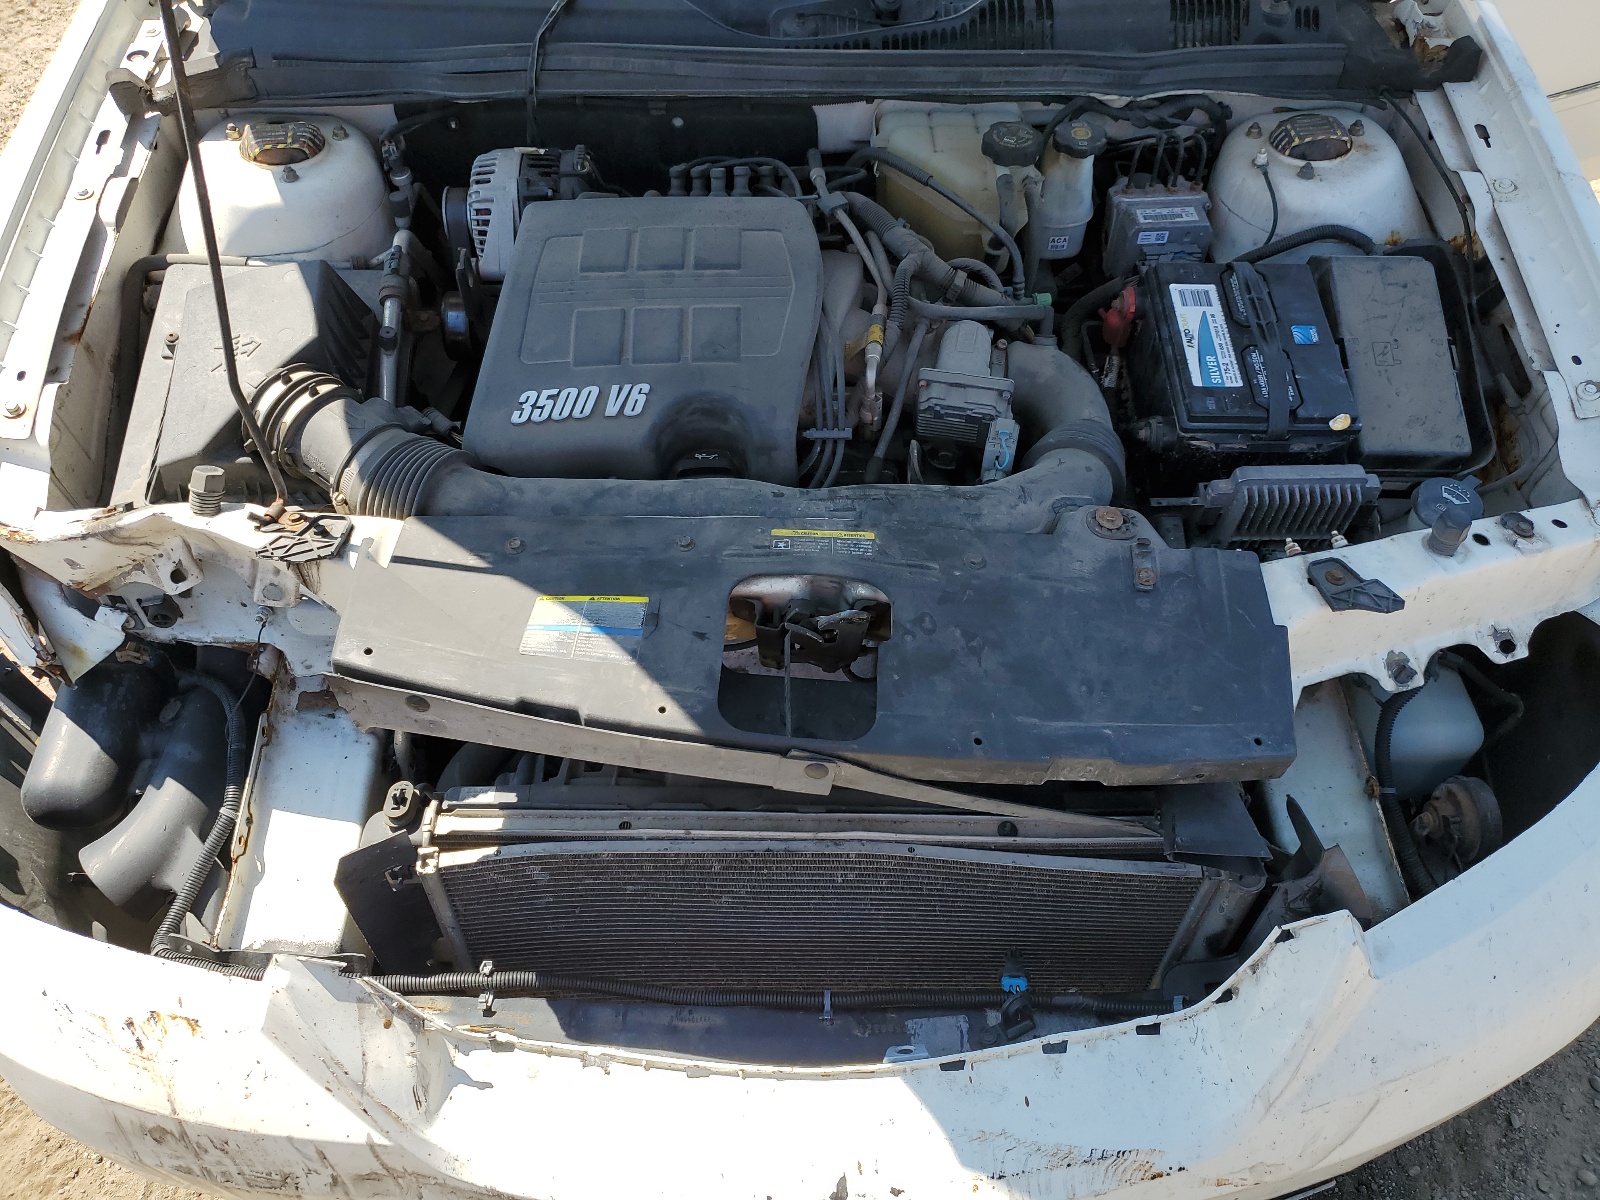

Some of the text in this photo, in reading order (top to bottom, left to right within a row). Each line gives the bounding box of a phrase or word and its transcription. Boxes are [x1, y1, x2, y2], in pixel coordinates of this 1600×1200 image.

[1206, 355, 1221, 384] SILVER
[510, 383, 650, 424] 3500 V6
